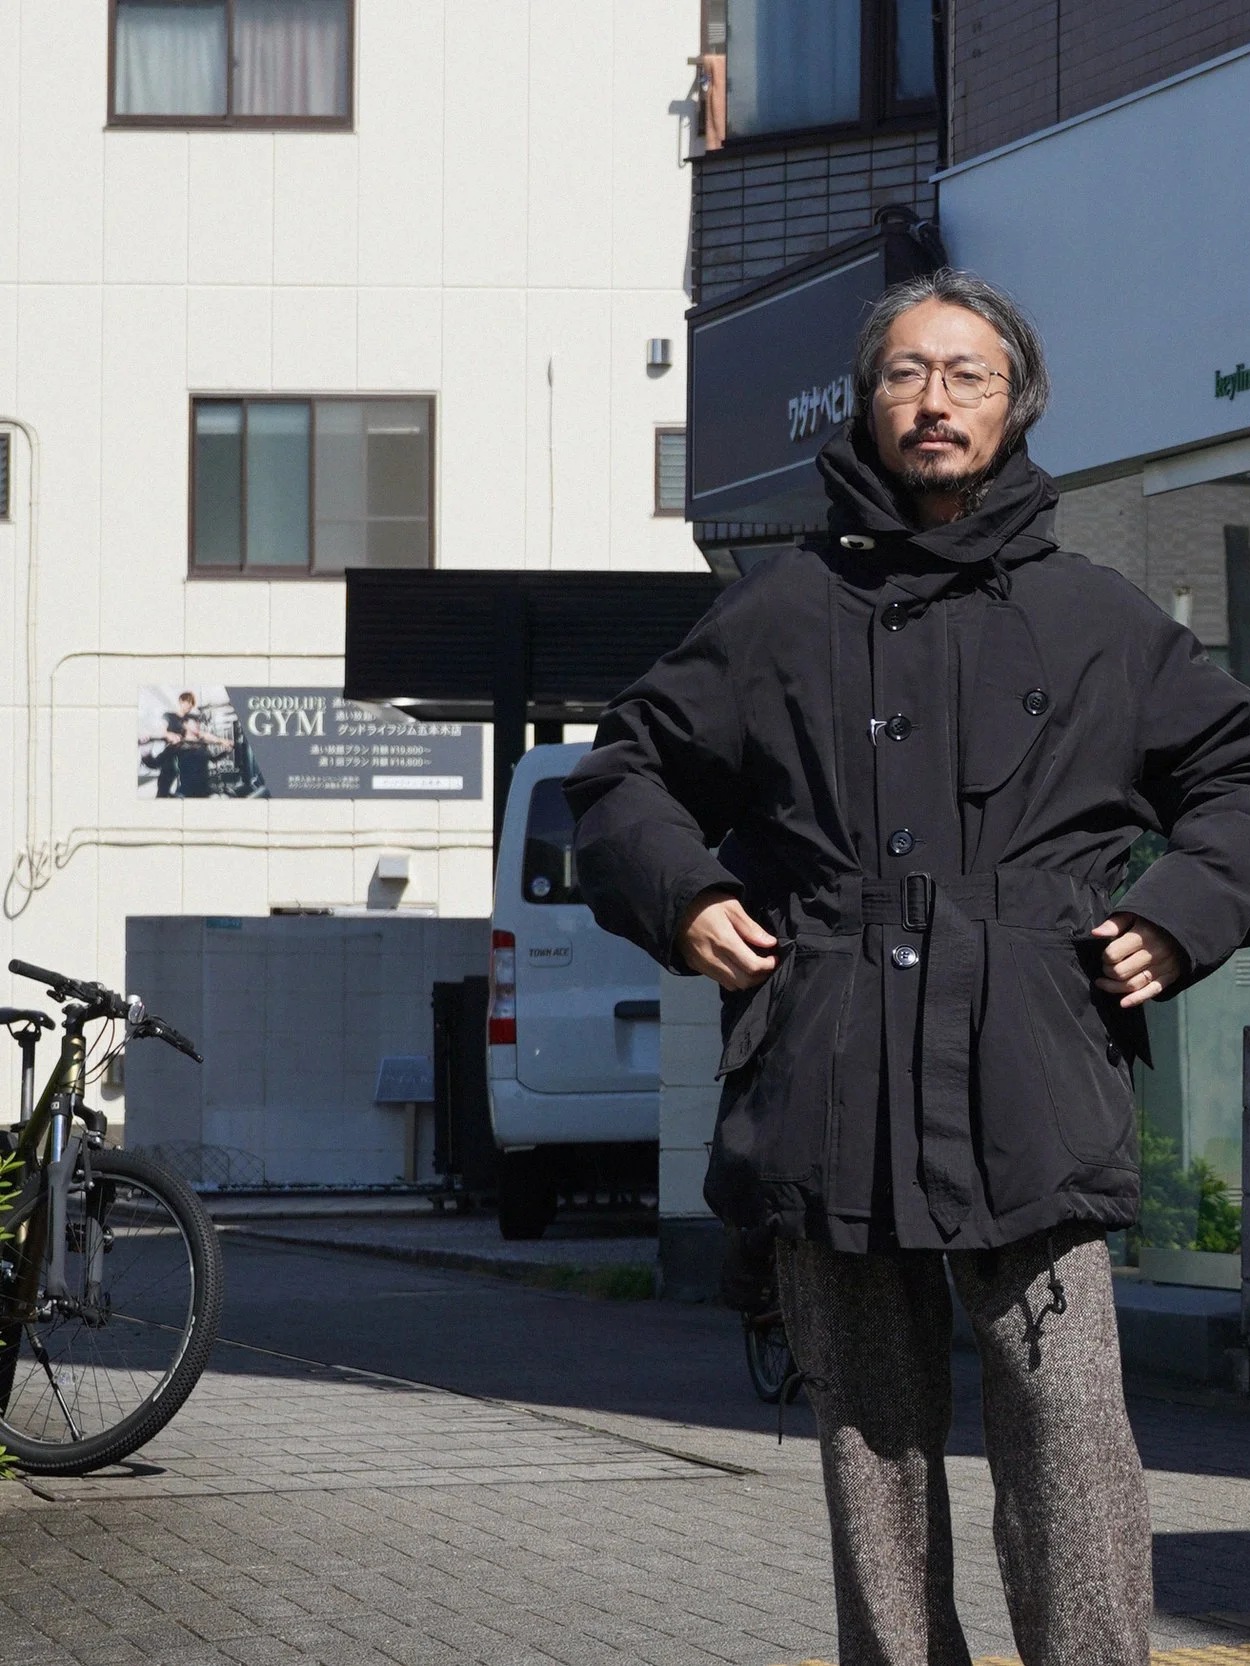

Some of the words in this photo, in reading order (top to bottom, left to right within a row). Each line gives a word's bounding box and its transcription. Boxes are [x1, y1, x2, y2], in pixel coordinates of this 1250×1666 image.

[248, 710, 326, 736] GYM
[529, 948, 553, 957] TOWN
[554, 948, 569, 957] ACE
